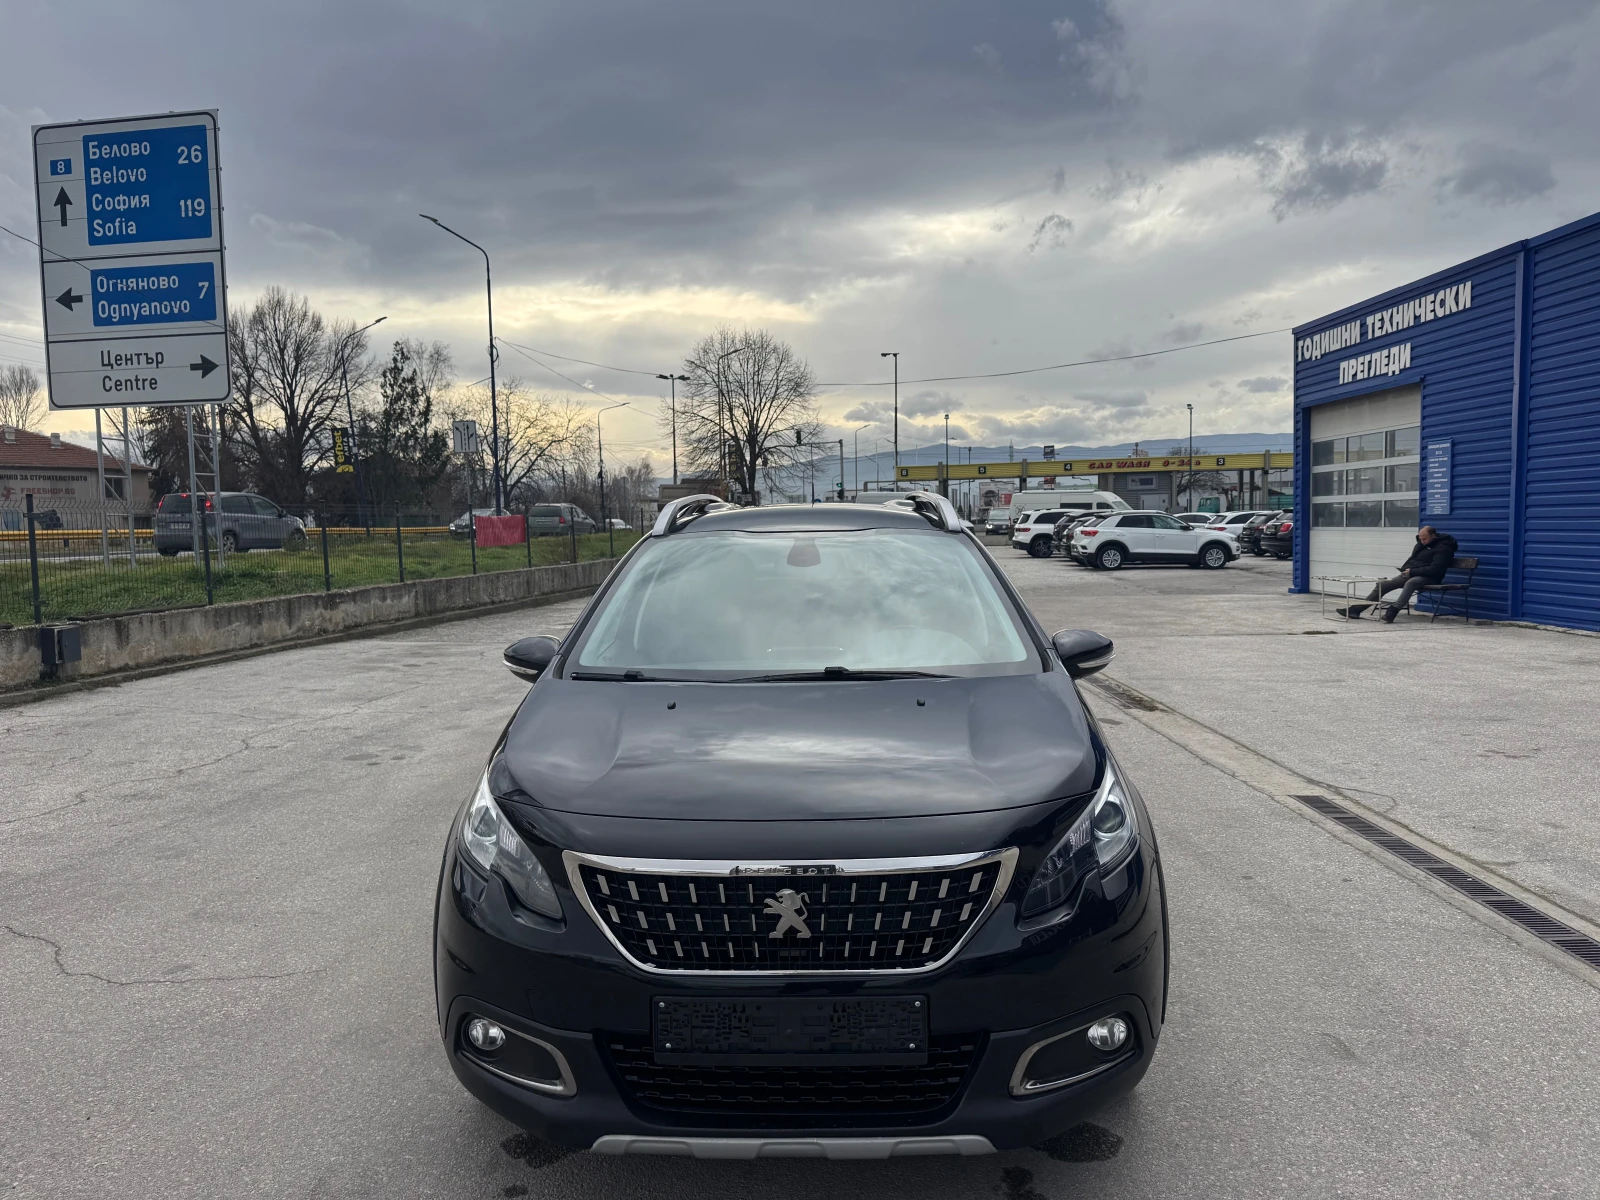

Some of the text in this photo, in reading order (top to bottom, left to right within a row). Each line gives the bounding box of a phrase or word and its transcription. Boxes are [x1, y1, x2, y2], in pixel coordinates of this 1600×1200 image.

[88, 141, 151, 160] Белово
[177, 145, 203, 165] 26
[57, 161, 65, 173] 8
[90, 166, 147, 185] Belovo
[91, 193, 150, 211] София
[180, 199, 206, 217] 119
[93, 219, 137, 237] Sofia
[96, 275, 179, 293] Огняново
[198, 281, 209, 299] 7
[98, 299, 190, 321] Ognyanovo
[1298, 281, 1472, 362] ГОДИШНИ ТЕХНИЧЕСКИ
[100, 349, 165, 369] Център
[1339, 342, 1412, 385] ПРЕГЛЕДИ
[102, 374, 158, 392] Centre
[333, 430, 344, 463] efbet
[1088, 461, 1113, 469] CAR
[1116, 460, 1151, 468] WASH
[744, 867, 830, 875] PEUGEOT
